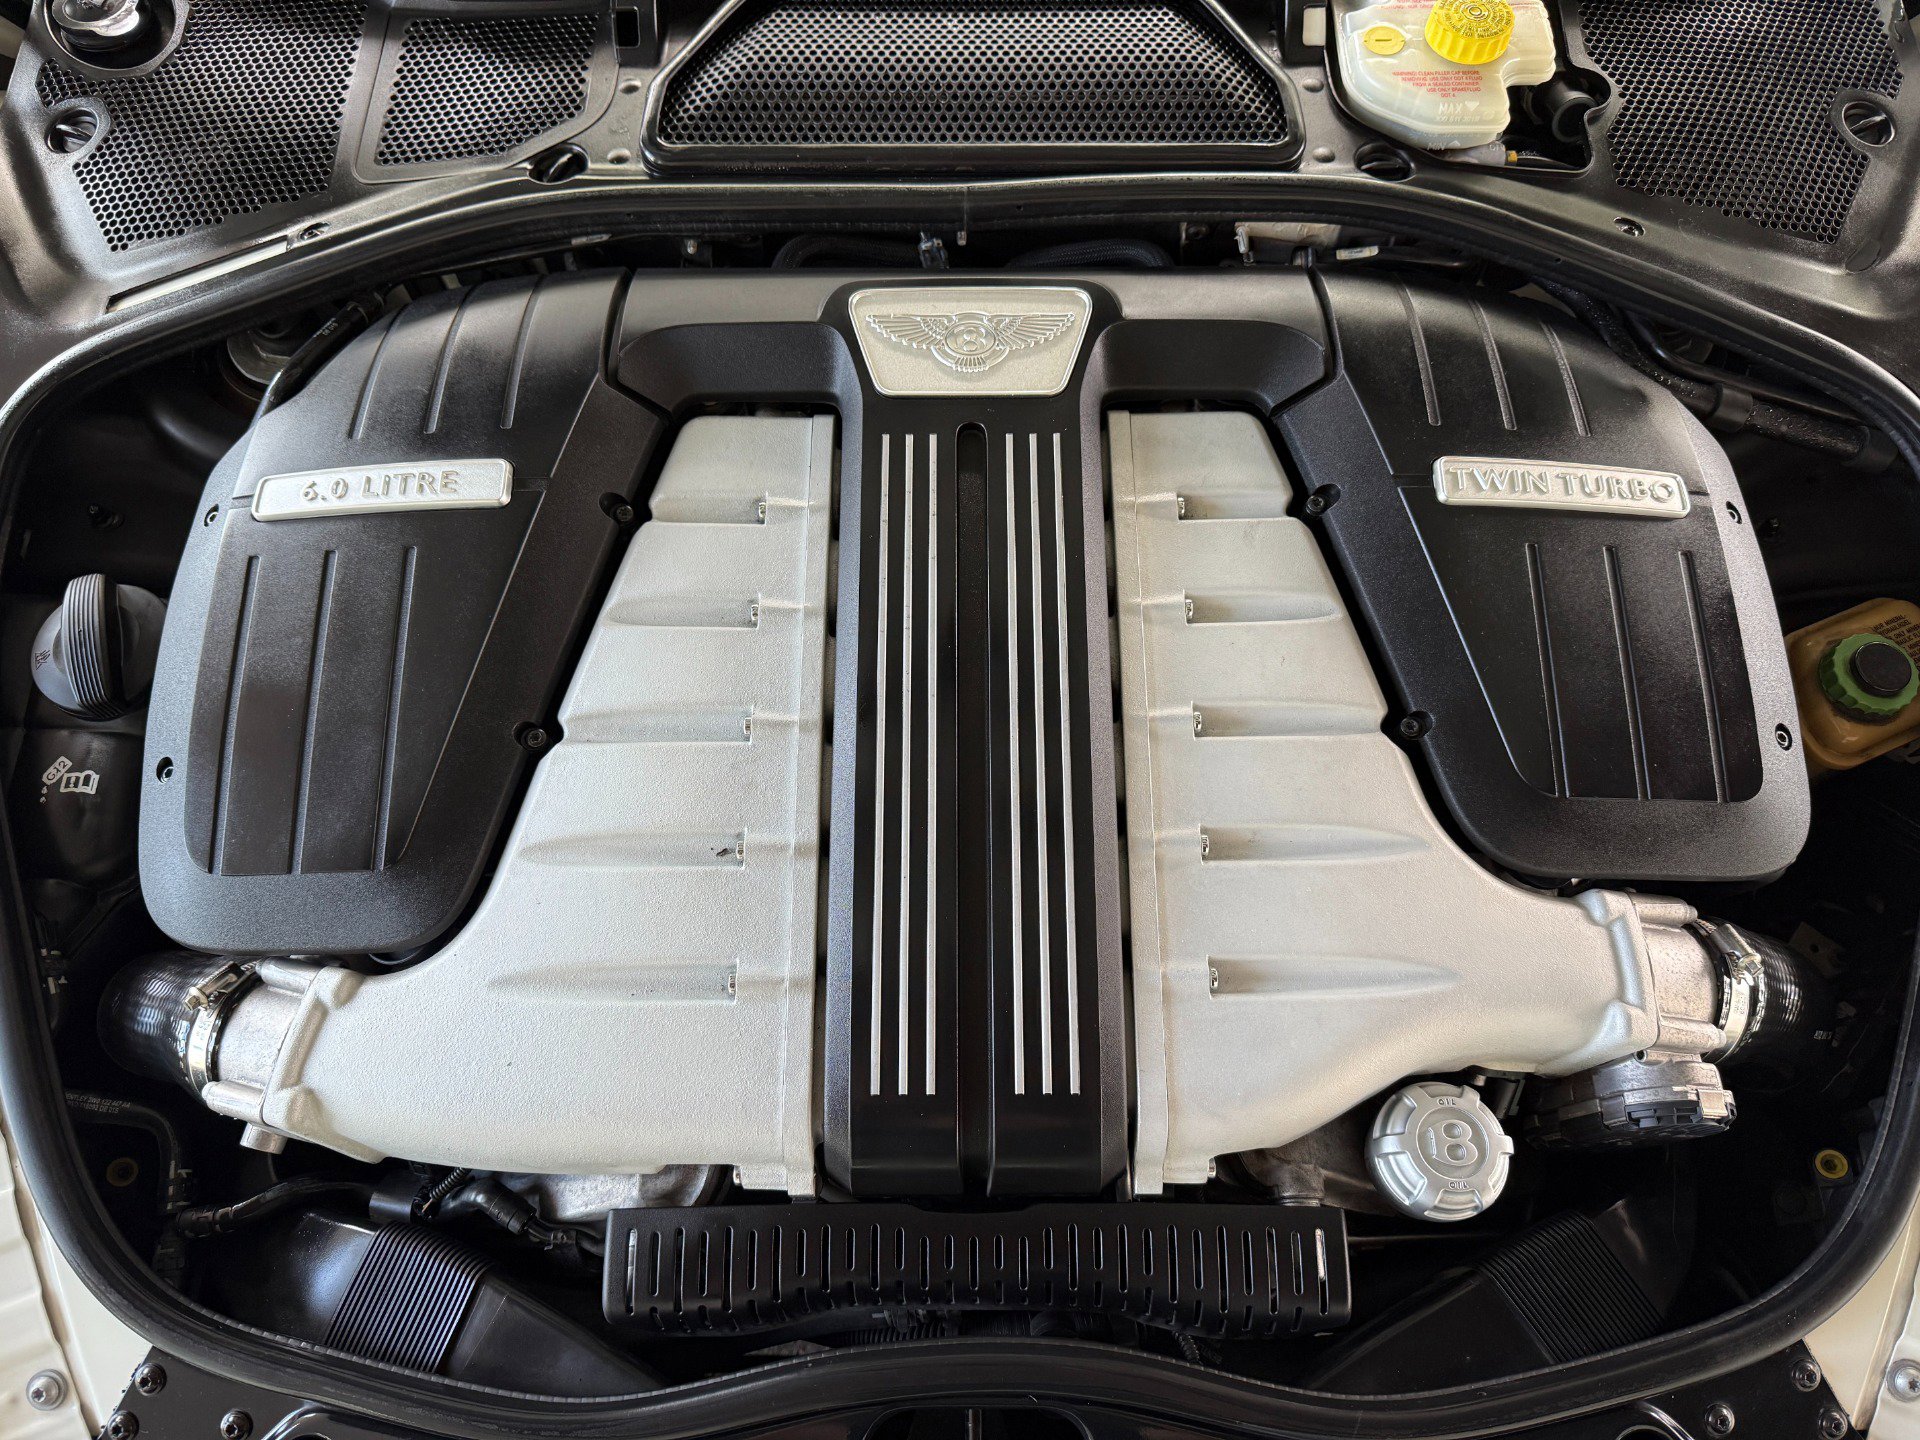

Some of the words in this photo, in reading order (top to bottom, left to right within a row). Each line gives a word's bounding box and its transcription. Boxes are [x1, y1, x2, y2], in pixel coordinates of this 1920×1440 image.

[1439, 102, 1462, 114] MAX
[302, 481, 348, 501] 6.0
[361, 470, 461, 499] LITRE
[1450, 467, 1550, 494] TWIN
[1559, 472, 1675, 503] TURBO
[46, 760, 69, 781] G12
[1437, 1098, 1456, 1106] OIL
[1427, 1119, 1478, 1167] B
[1449, 1181, 1469, 1189] OIL
